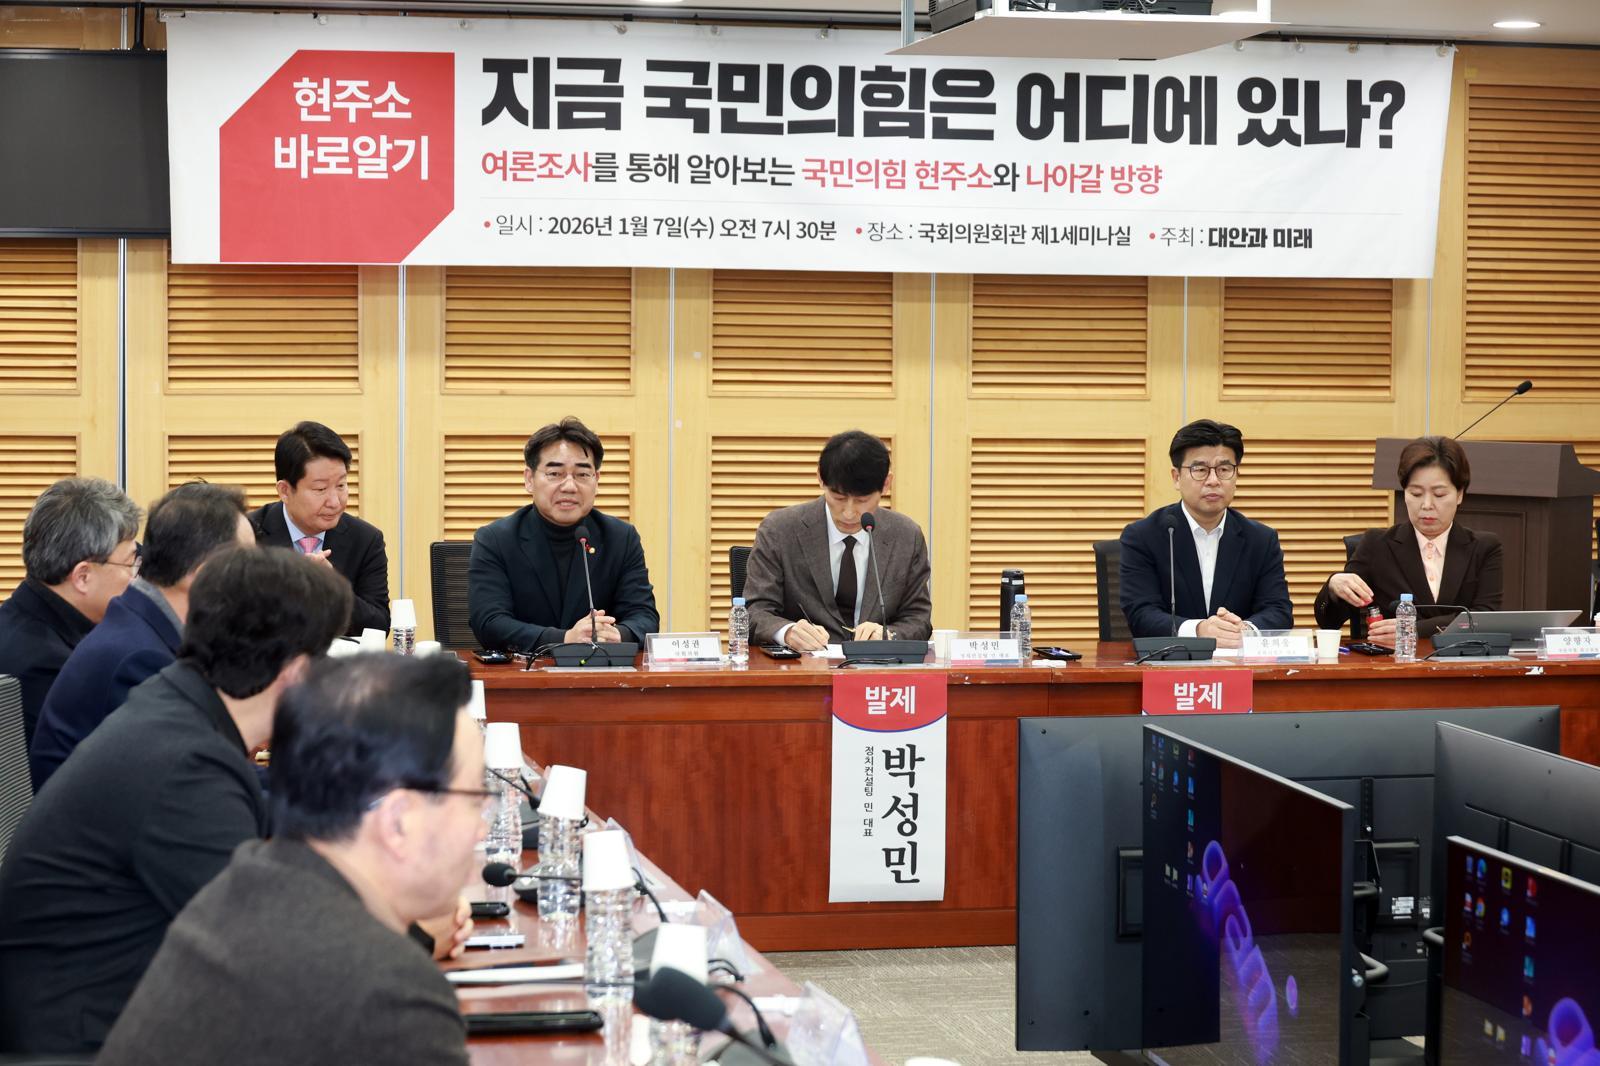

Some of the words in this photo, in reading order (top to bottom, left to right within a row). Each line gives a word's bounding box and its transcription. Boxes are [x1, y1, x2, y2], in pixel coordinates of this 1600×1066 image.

[293, 77, 412, 122] 현주소
[482, 56, 625, 131] 지금
[643, 59, 997, 141] 국민의힘은
[1016, 72, 1217, 146] 어디에
[1237, 77, 1406, 149] 있나?
[274, 133, 429, 181] 바로알기
[481, 150, 618, 183] 여론조사를
[626, 152, 680, 185] 통해
[686, 154, 796, 187] 알아보는
[802, 158, 907, 190] 국민의힘
[914, 160, 1020, 192] 현주소와
[1026, 162, 1104, 194] 나아갈
[1110, 164, 1163, 195] 방향
[547, 215, 613, 237] 2026년
[618, 215, 648, 237] 1월
[653, 215, 715, 240] 7일(수)
[720, 218, 757, 240] 오전
[761, 219, 791, 241] 7시
[796, 220, 838, 241] 30분
[917, 222, 1027, 245] 국회의원회관
[1031, 224, 1131, 247] 제1세미나실
[1207, 226, 1268, 249] 대안과
[1272, 228, 1313, 249] 미래
[865, 685, 916, 715] 발제
[1174, 682, 1223, 711] 발제
[864, 746, 874, 796] 정치컨설팅
[863, 817, 873, 837] 대표
[881, 743, 926, 884] 박성민
